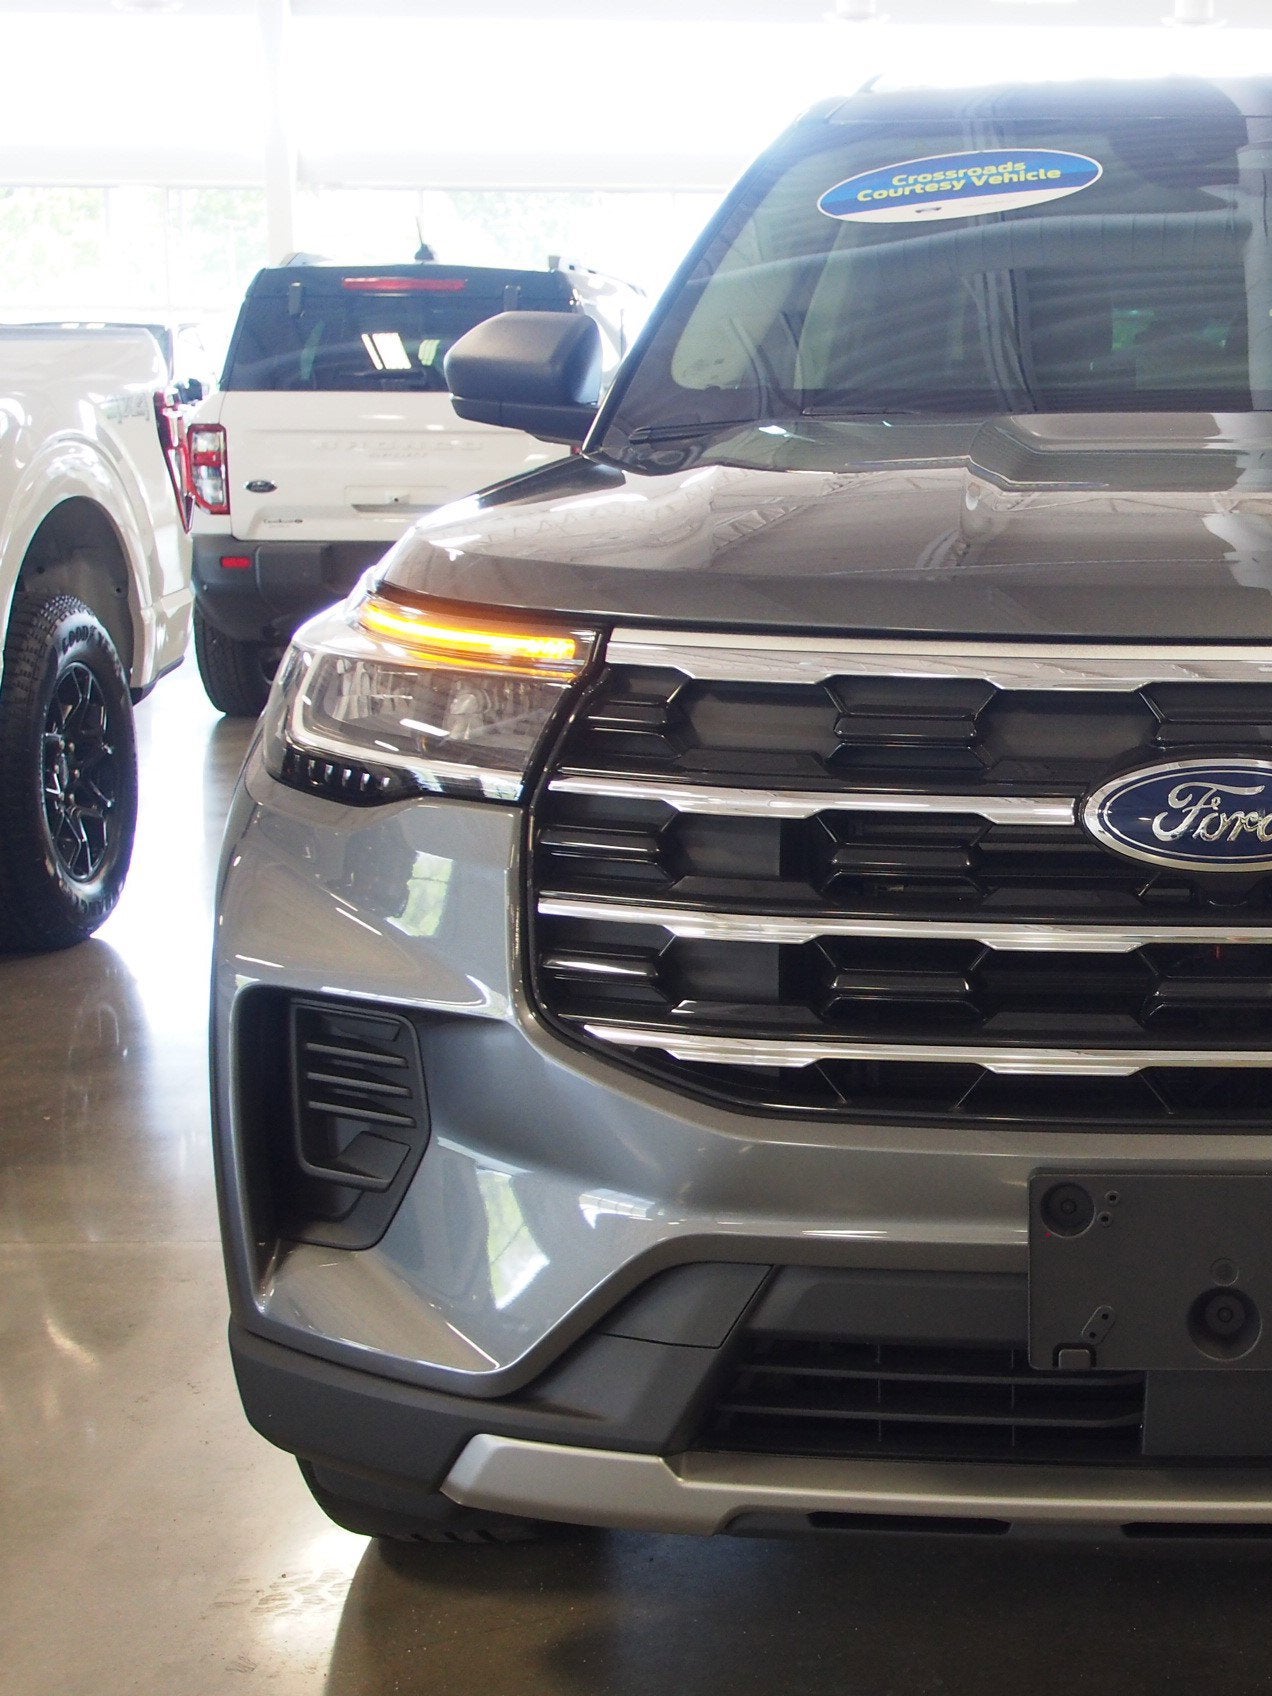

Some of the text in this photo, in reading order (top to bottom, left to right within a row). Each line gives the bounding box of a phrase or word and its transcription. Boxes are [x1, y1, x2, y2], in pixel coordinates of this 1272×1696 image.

[856, 167, 1062, 202] Courtesy Vehicle
[891, 161, 1027, 186] Crossroads
